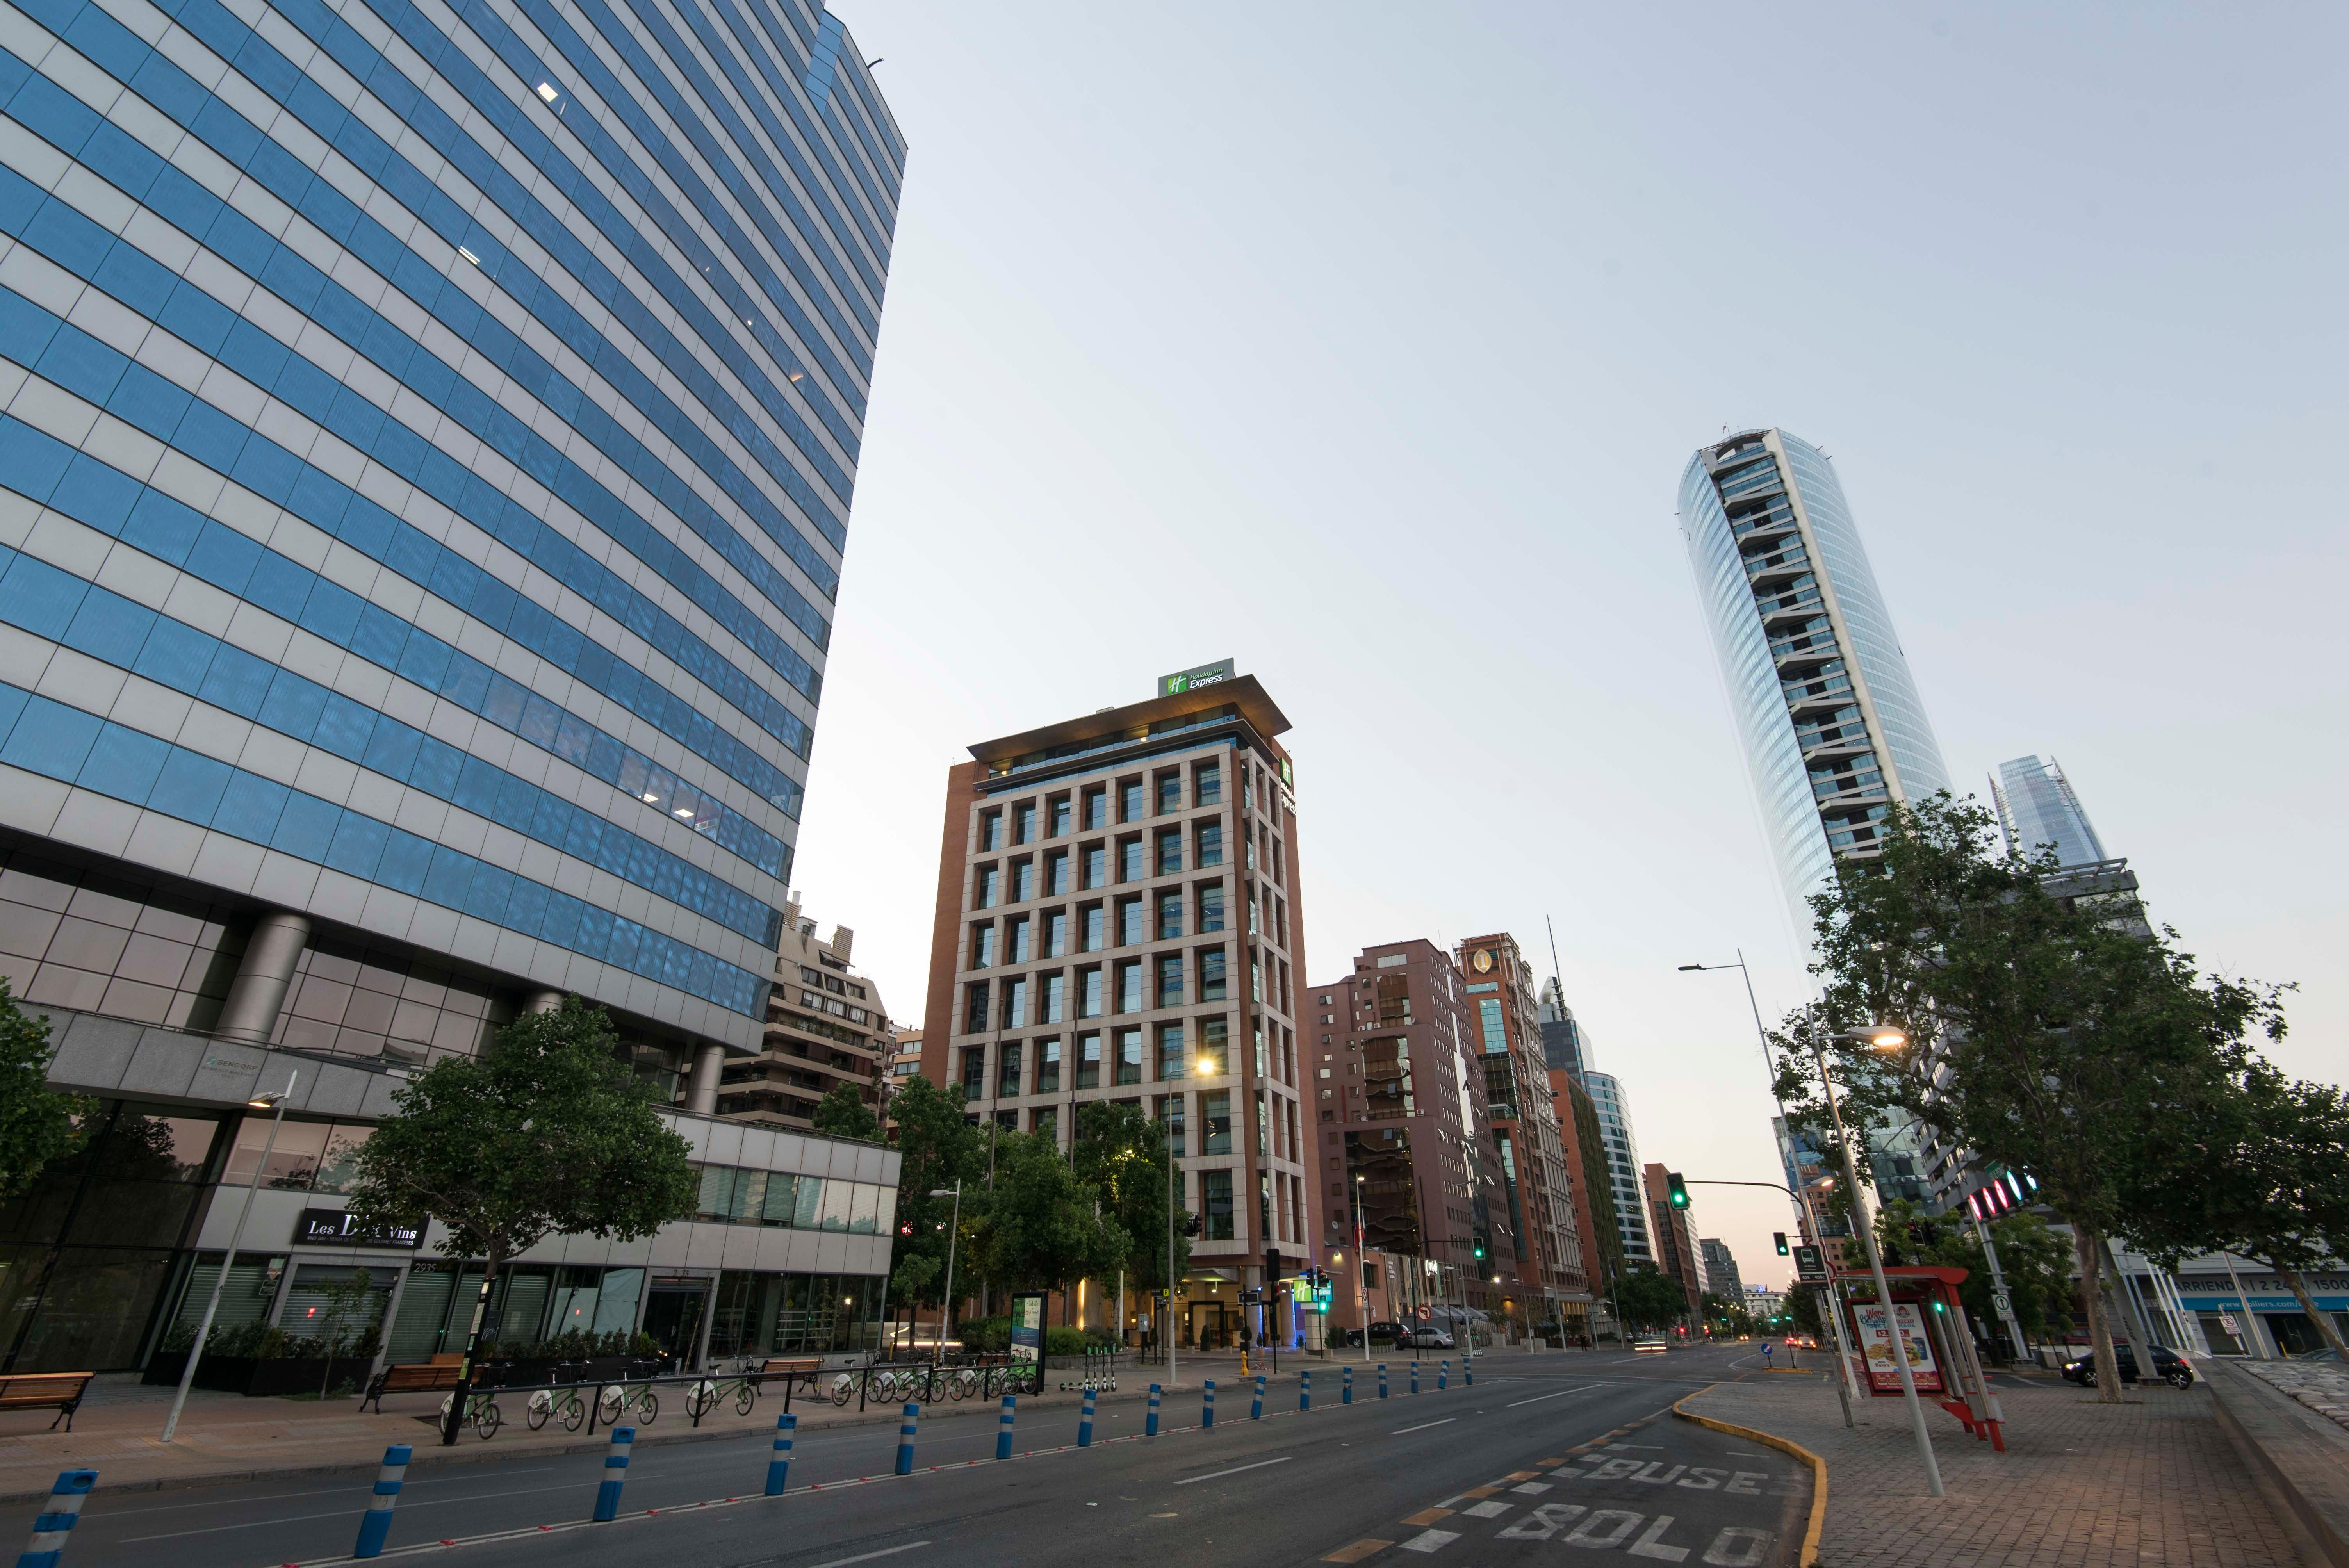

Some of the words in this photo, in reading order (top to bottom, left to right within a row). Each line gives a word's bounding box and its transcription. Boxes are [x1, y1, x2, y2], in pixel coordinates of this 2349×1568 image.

[1190, 671, 1212, 681] Holiday
[1190, 674, 1223, 689] Express
[1281, 789, 1297, 816] xpress
[217, 1060, 258, 1071] SENCORP
[308, 1221, 335, 1234] Les
[390, 1226, 417, 1239] Vins
[414, 1263, 437, 1273] 2935
[1494, 1503, 1775, 1567] SOLO
